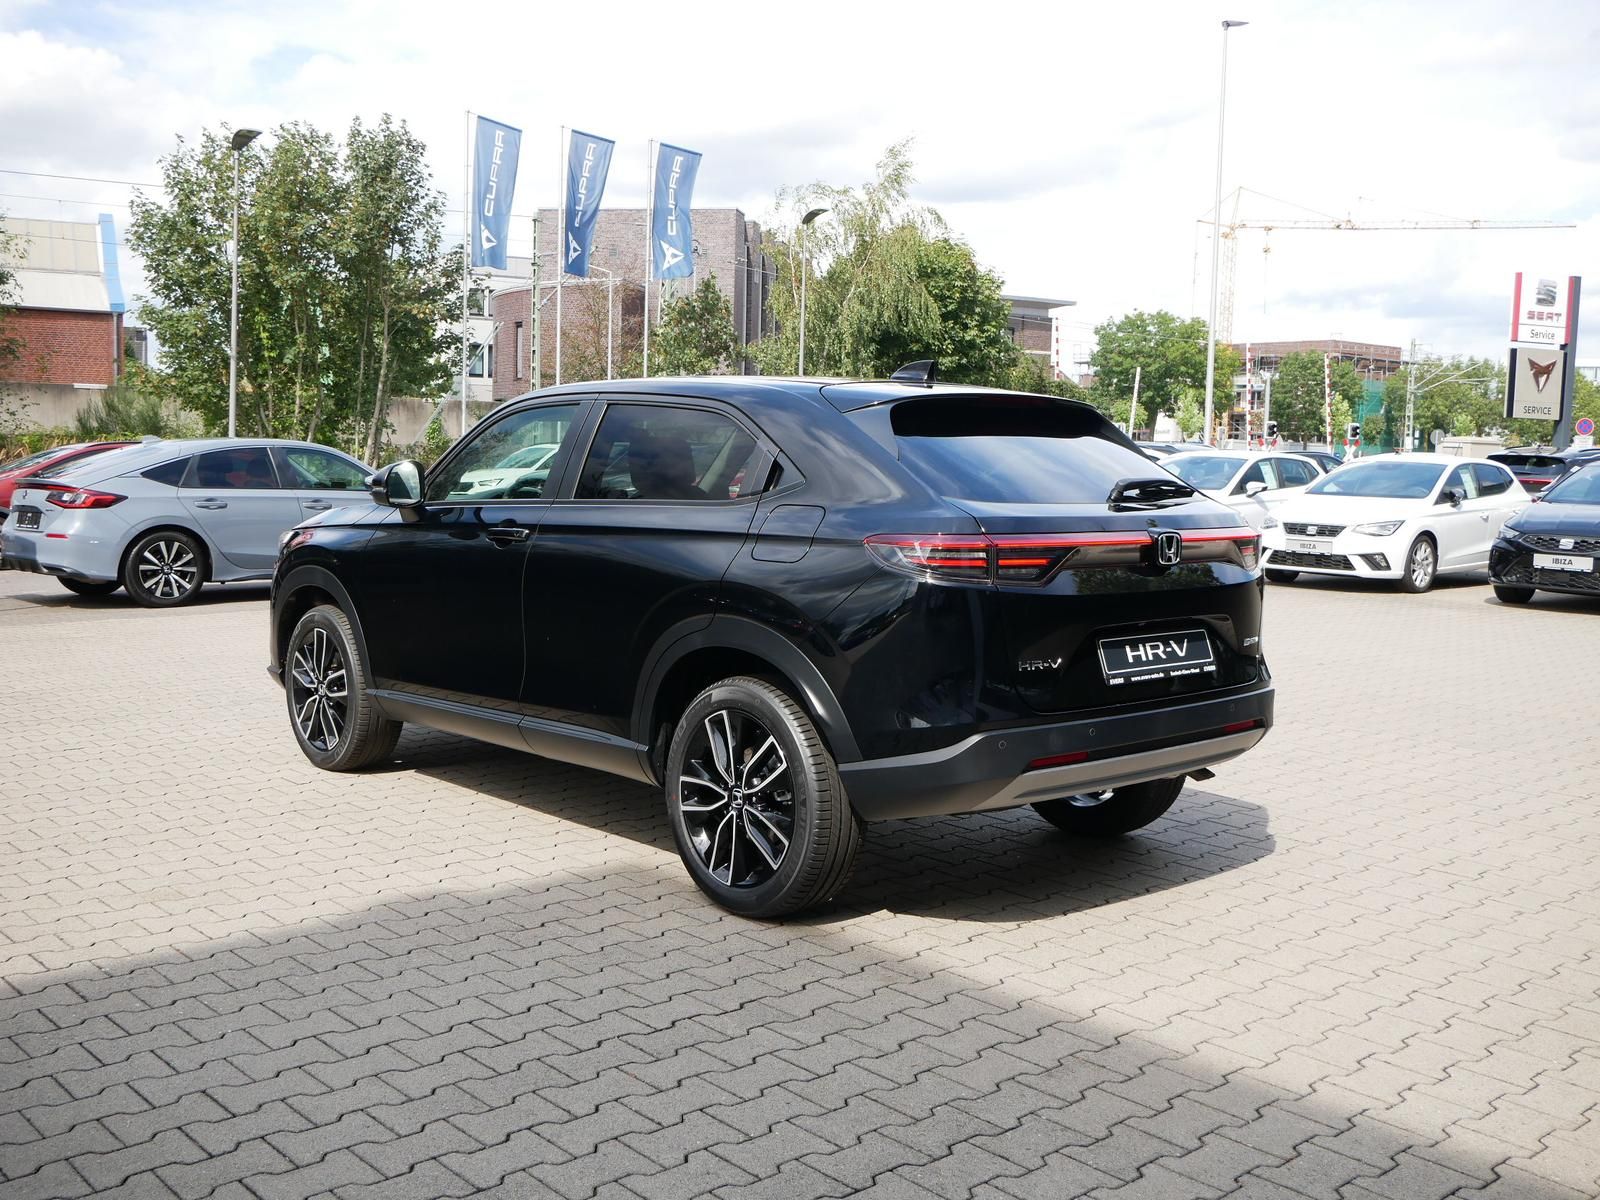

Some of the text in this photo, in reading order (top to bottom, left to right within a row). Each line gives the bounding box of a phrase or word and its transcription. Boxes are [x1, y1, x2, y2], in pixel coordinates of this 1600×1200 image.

[484, 129, 505, 217] CUPRA
[574, 142, 597, 227] CUPRA
[667, 155, 684, 236] CUPRA
[1526, 310, 1562, 322] SEAT
[1530, 329, 1556, 340] Service
[1523, 405, 1552, 416] SERVICE
[1552, 557, 1574, 566] IBIZA
[1125, 638, 1188, 663] HR-V
[1018, 657, 1062, 671] HR-V
